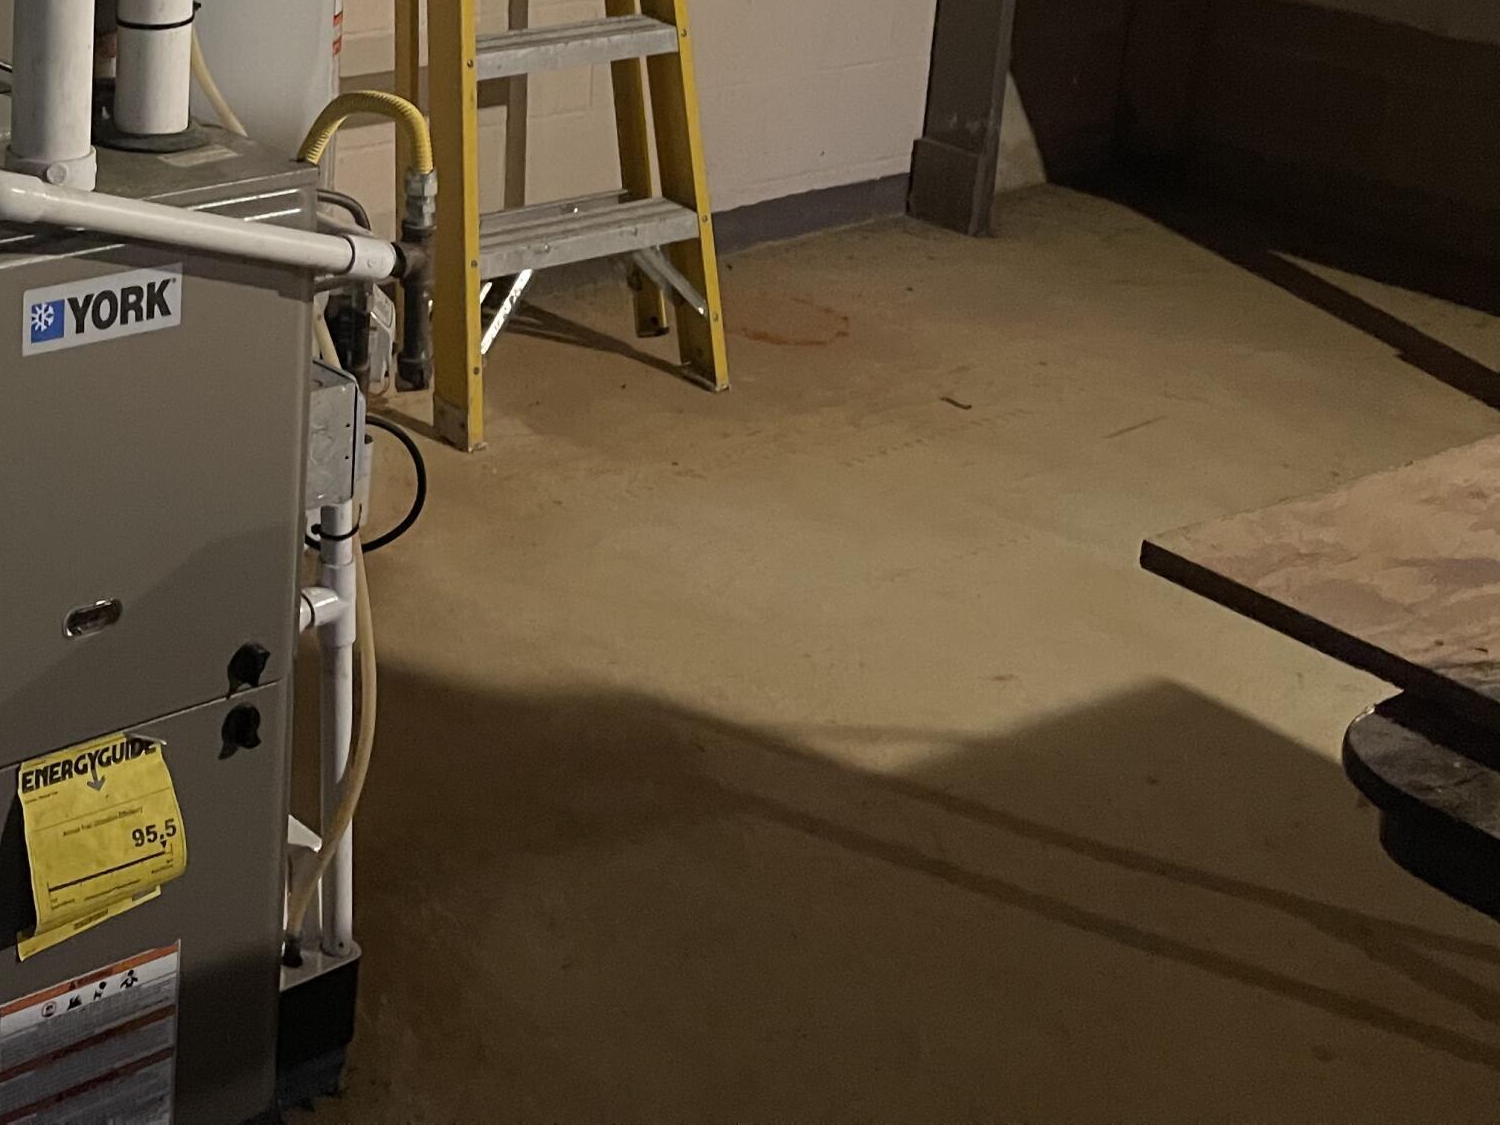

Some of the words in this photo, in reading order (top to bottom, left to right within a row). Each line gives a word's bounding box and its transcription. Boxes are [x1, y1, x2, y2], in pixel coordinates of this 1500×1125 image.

[67, 279, 172, 334] YORK
[22, 738, 157, 794] ENERGYGUIDE
[131, 818, 178, 848] 95.5
